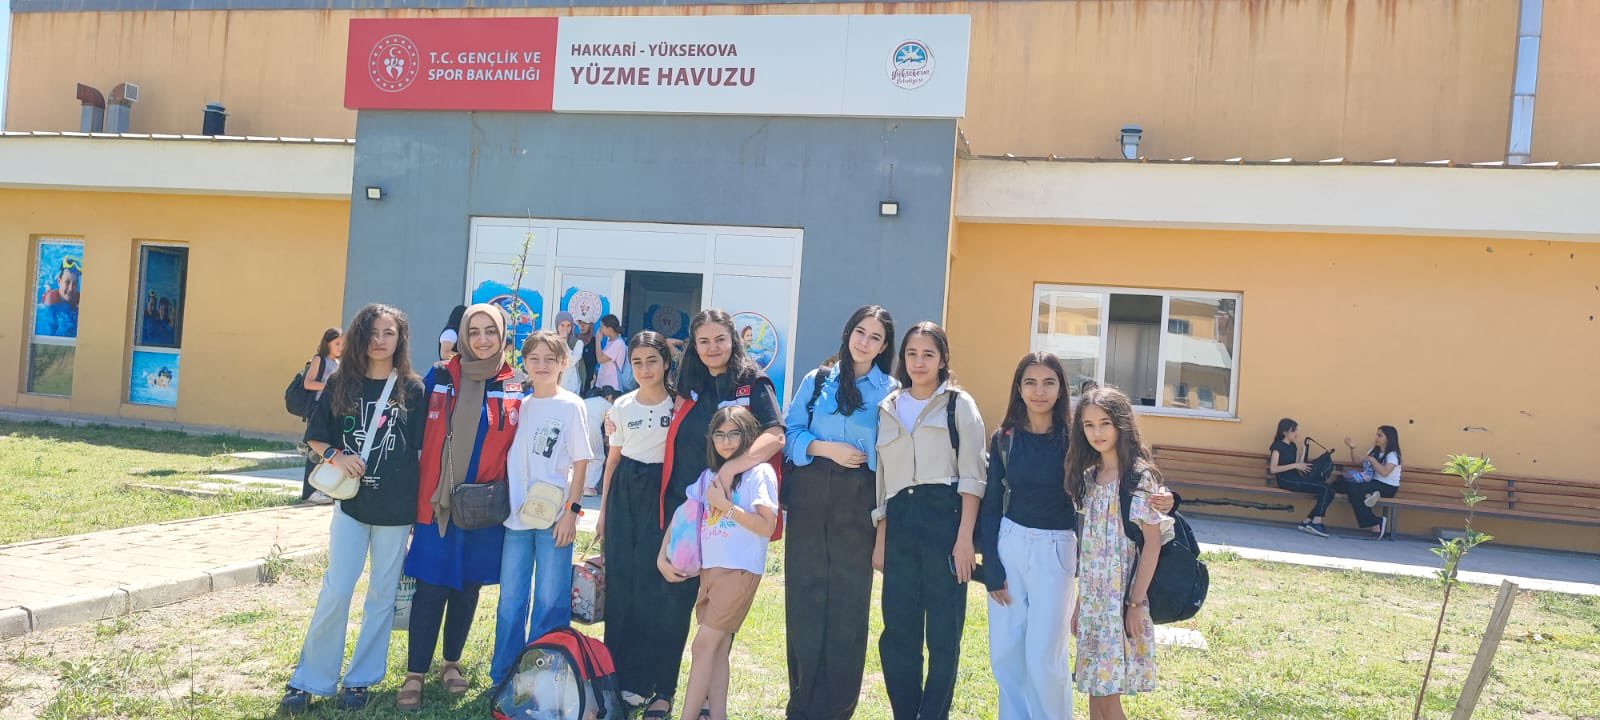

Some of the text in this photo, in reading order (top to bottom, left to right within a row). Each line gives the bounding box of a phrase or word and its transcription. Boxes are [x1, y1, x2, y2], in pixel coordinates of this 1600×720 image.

[571, 42, 636, 57] HAKKARİ
[648, 42, 738, 57] YÜKSEKOVA
[429, 49, 541, 67] T.C. GENÇLİK VE
[428, 66, 540, 81] SPOR BAKANLIĞI
[570, 62, 756, 86] YÜZME HAVUZU
